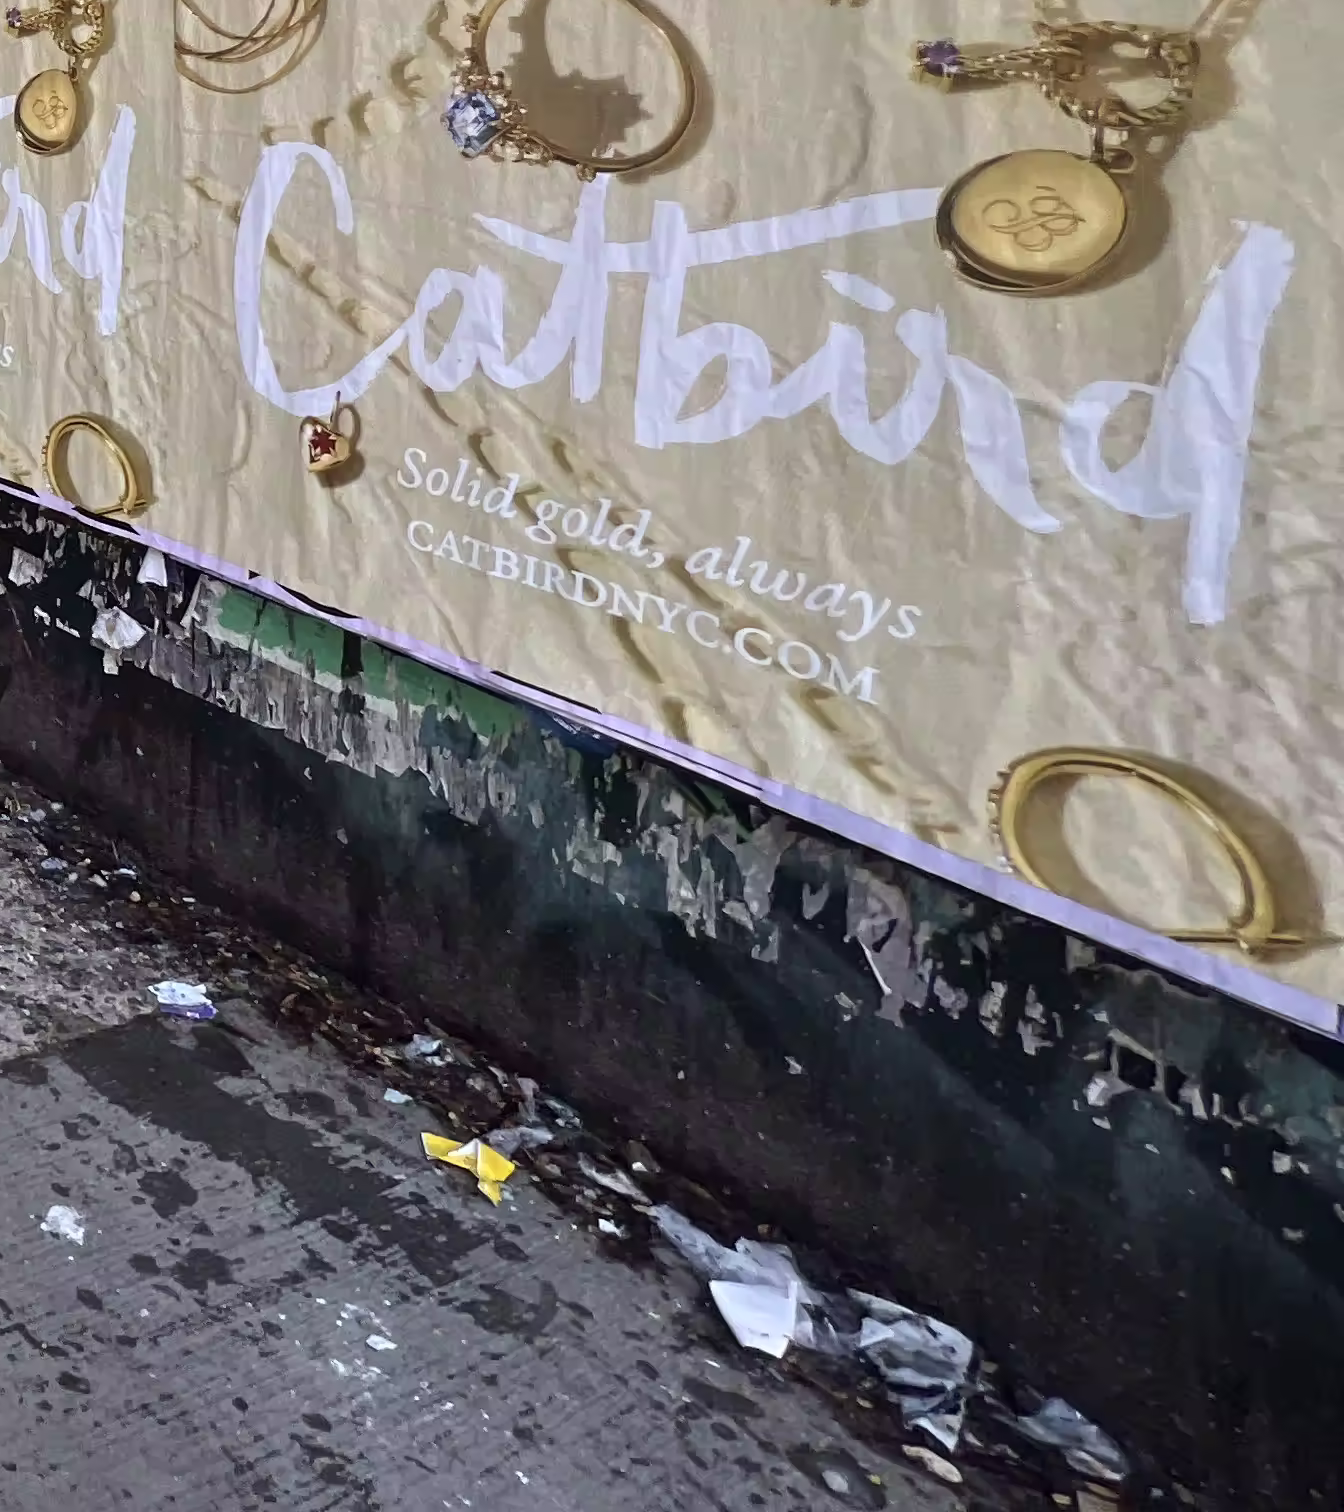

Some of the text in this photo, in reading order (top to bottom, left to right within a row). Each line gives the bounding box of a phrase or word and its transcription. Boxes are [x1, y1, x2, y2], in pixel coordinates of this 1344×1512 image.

[234, 142, 1295, 626] Catbird
[397, 447, 923, 642] Solid gold, always
[407, 520, 879, 706] CATBIRDNYC.COM
